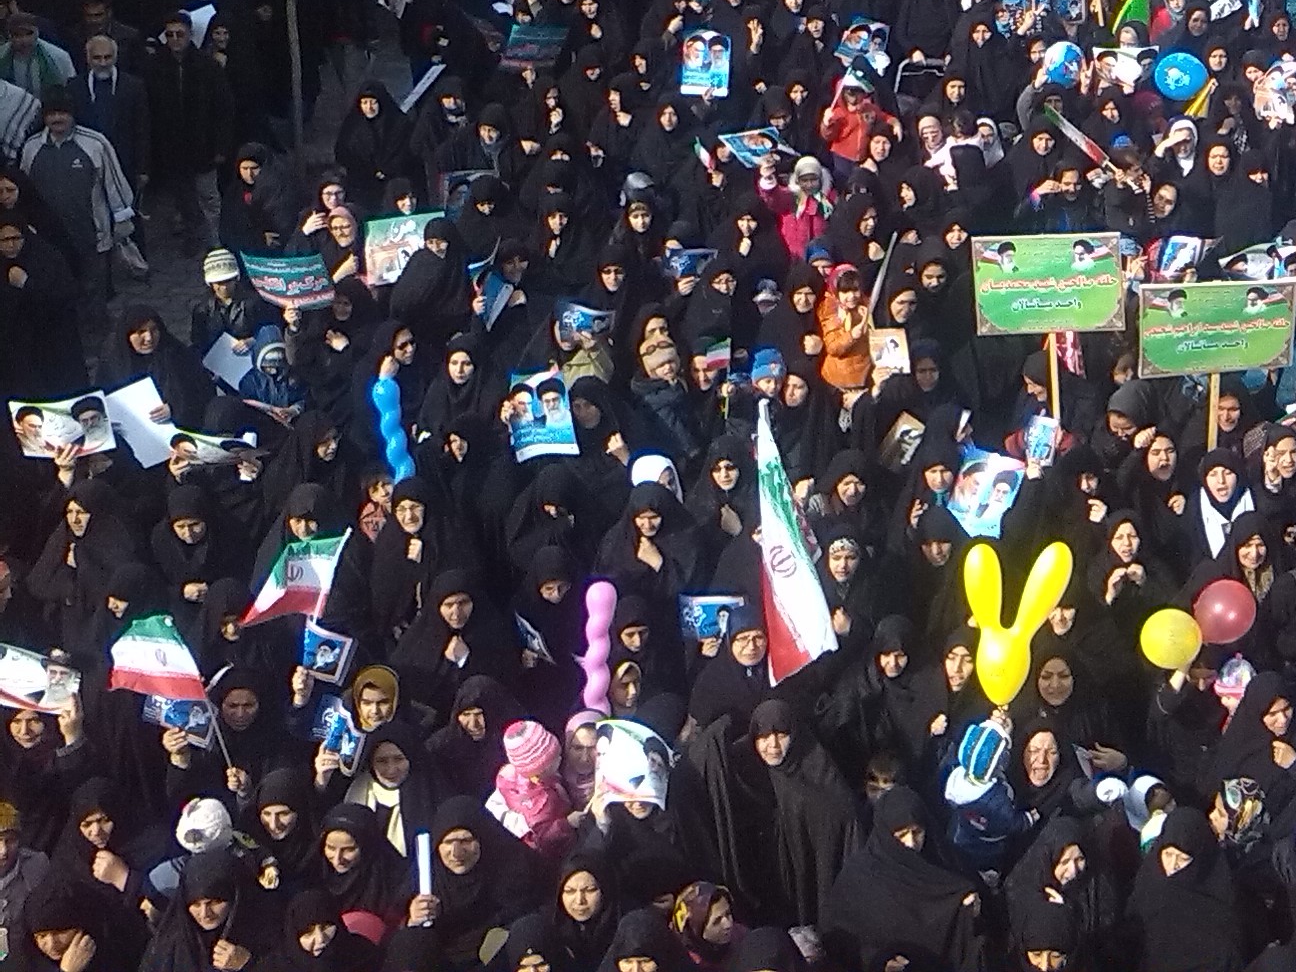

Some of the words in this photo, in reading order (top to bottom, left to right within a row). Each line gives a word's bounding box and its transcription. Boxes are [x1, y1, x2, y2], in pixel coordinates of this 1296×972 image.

[299, 275, 329, 292] مرگ
[1055, 297, 1083, 310] واحد
[1222, 339, 1249, 350] واحد
